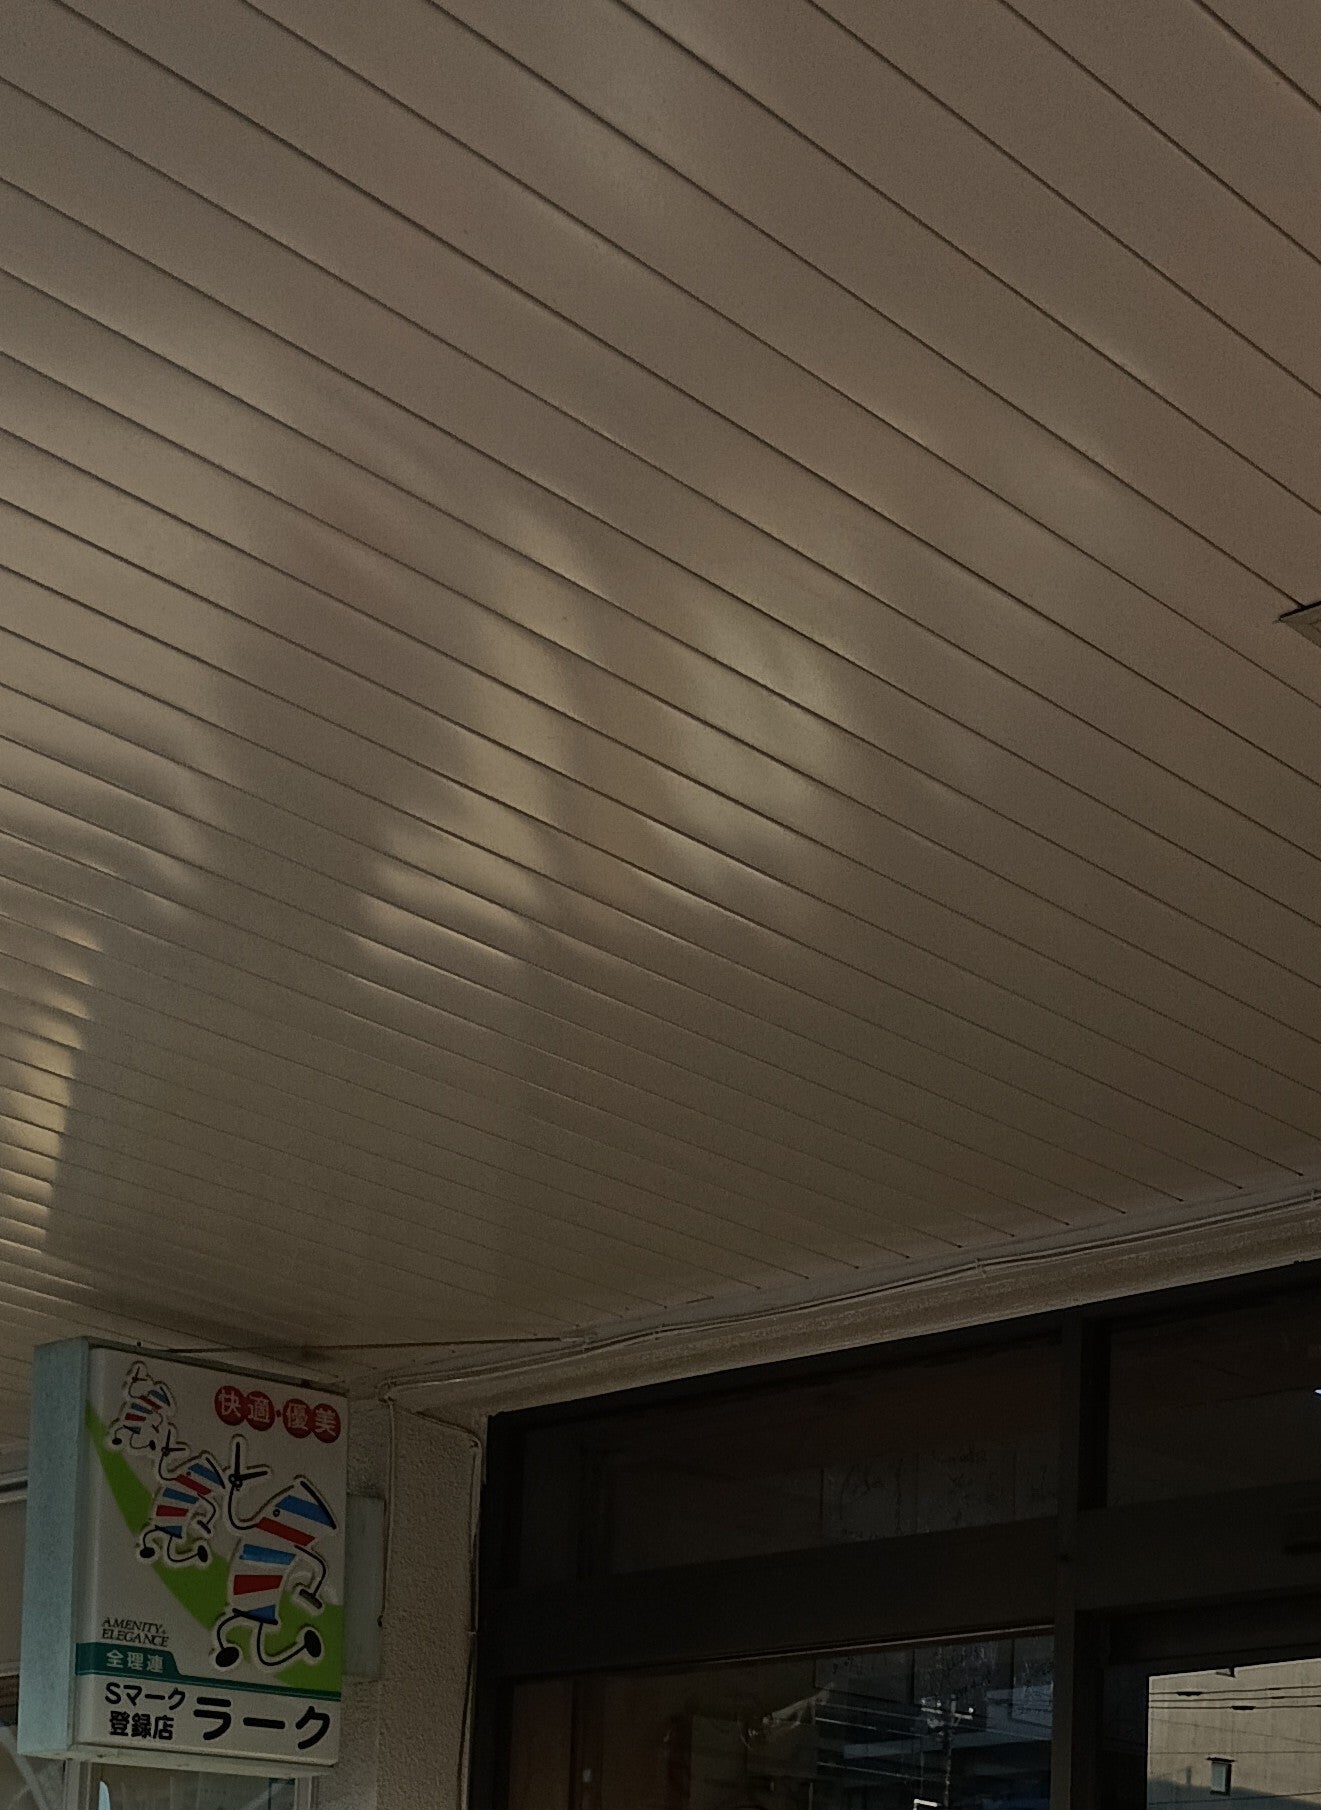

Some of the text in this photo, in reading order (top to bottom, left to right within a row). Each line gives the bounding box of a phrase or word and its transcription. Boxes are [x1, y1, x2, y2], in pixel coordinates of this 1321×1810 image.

[217, 1388, 338, 1437] 快適・優美
[102, 1629, 169, 1648] ELEGANCE
[106, 1649, 164, 1674] 全理連
[104, 1681, 186, 1711] Sマーク
[109, 1710, 174, 1741] 登録店
[193, 1696, 331, 1750] ラーク
